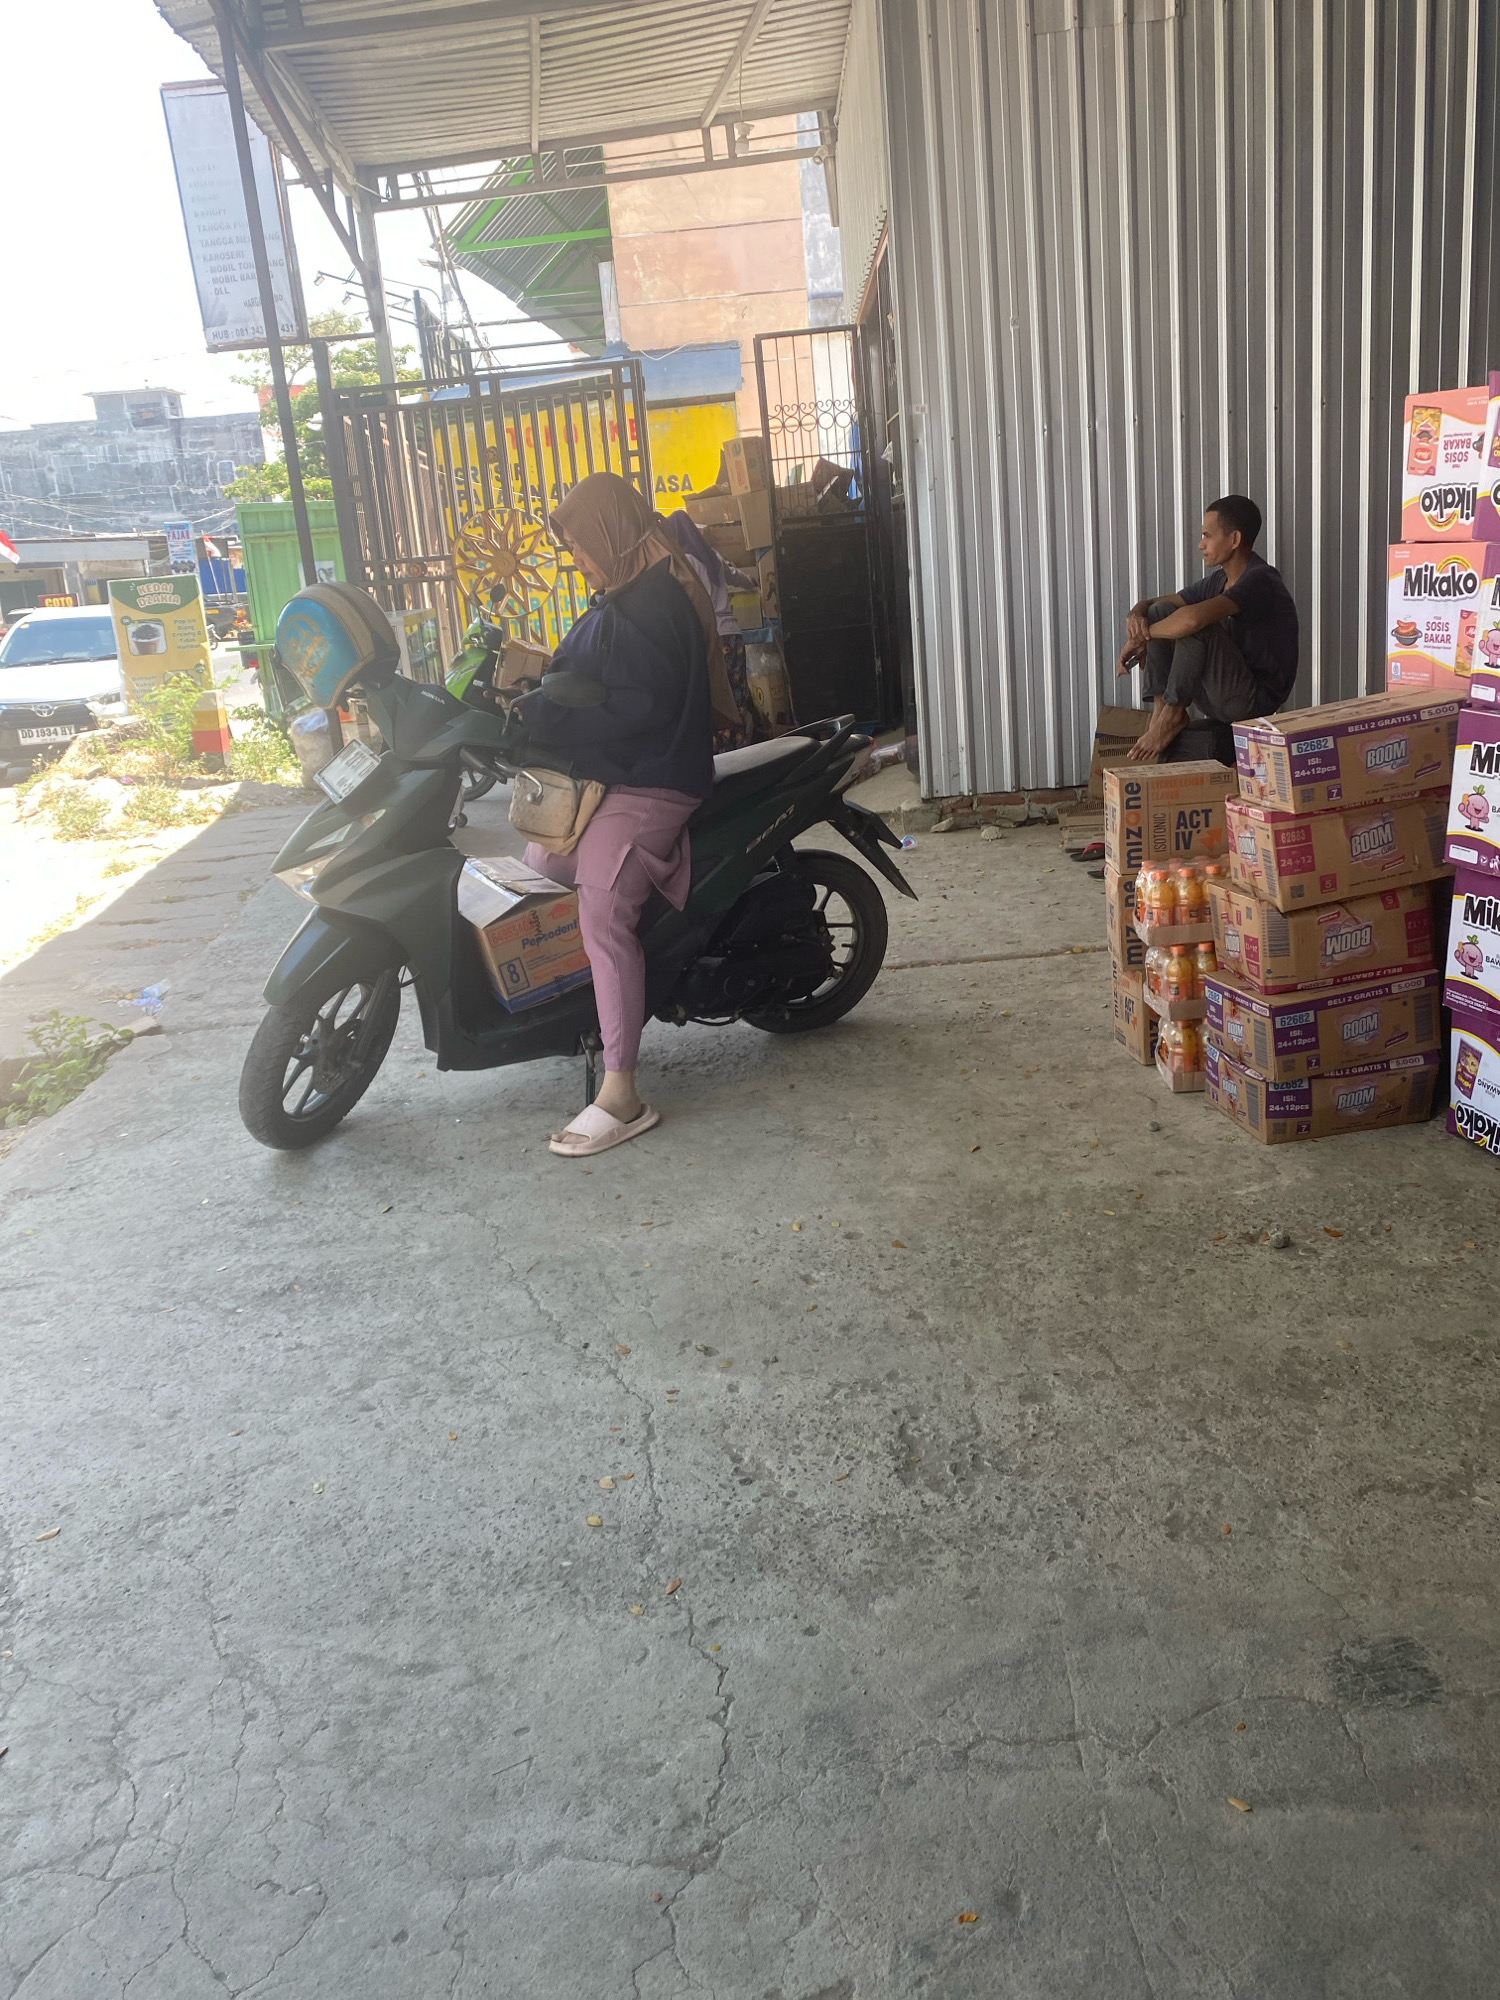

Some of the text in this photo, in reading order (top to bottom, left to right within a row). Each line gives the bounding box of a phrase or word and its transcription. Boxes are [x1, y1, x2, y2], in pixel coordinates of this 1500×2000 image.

[210, 264, 236, 274] MOBIL
[212, 275, 238, 285] MOBIL
[214, 286, 230, 295] DLL
[212, 330, 229, 341] HUB
[235, 328, 250, 338] 081
[280, 323, 294, 333] 431
[1444, 438, 1471, 450] BAKAR
[1445, 451, 1468, 463] SOSIS
[1404, 564, 1478, 597] Mikako
[138, 582, 173, 595] KEDAI
[1426, 621, 1450, 632] SOSIS
[1424, 632, 1452, 644] BAKAR
[1348, 723, 1368, 733] BELI
[1377, 714, 1411, 727] GRATIS
[1428, 705, 1455, 716] 5.000
[21, 728, 34, 739] DD
[35, 727, 59, 739] 1934
[1296, 738, 1329, 753] 62682
[1308, 757, 1322, 766] ISI:
[1366, 739, 1408, 769] BOOM
[1294, 765, 1337, 779] 24+12pcs
[1331, 789, 1338, 798] 7
[1125, 782, 1142, 868] mizone
[1176, 808, 1212, 830] ACT
[1153, 812, 1167, 853] ISOTONIC
[1351, 822, 1394, 857] BOOM
[1325, 925, 1372, 956] BOOM
[507, 962, 520, 983] 8
[1327, 997, 1345, 1006] BELI
[1354, 988, 1384, 1000] GRATIS
[1397, 980, 1422, 990] 5.000
[1280, 1012, 1310, 1027] 62682
[1343, 1012, 1379, 1040] BOOM
[1277, 1037, 1316, 1049] 24+12pcs
[1352, 1064, 1382, 1073] GRATIS
[1396, 1058, 1420, 1067] 5.000
[1337, 1085, 1376, 1112] BOOM
[1269, 1104, 1310, 1112] 24+12pcs
